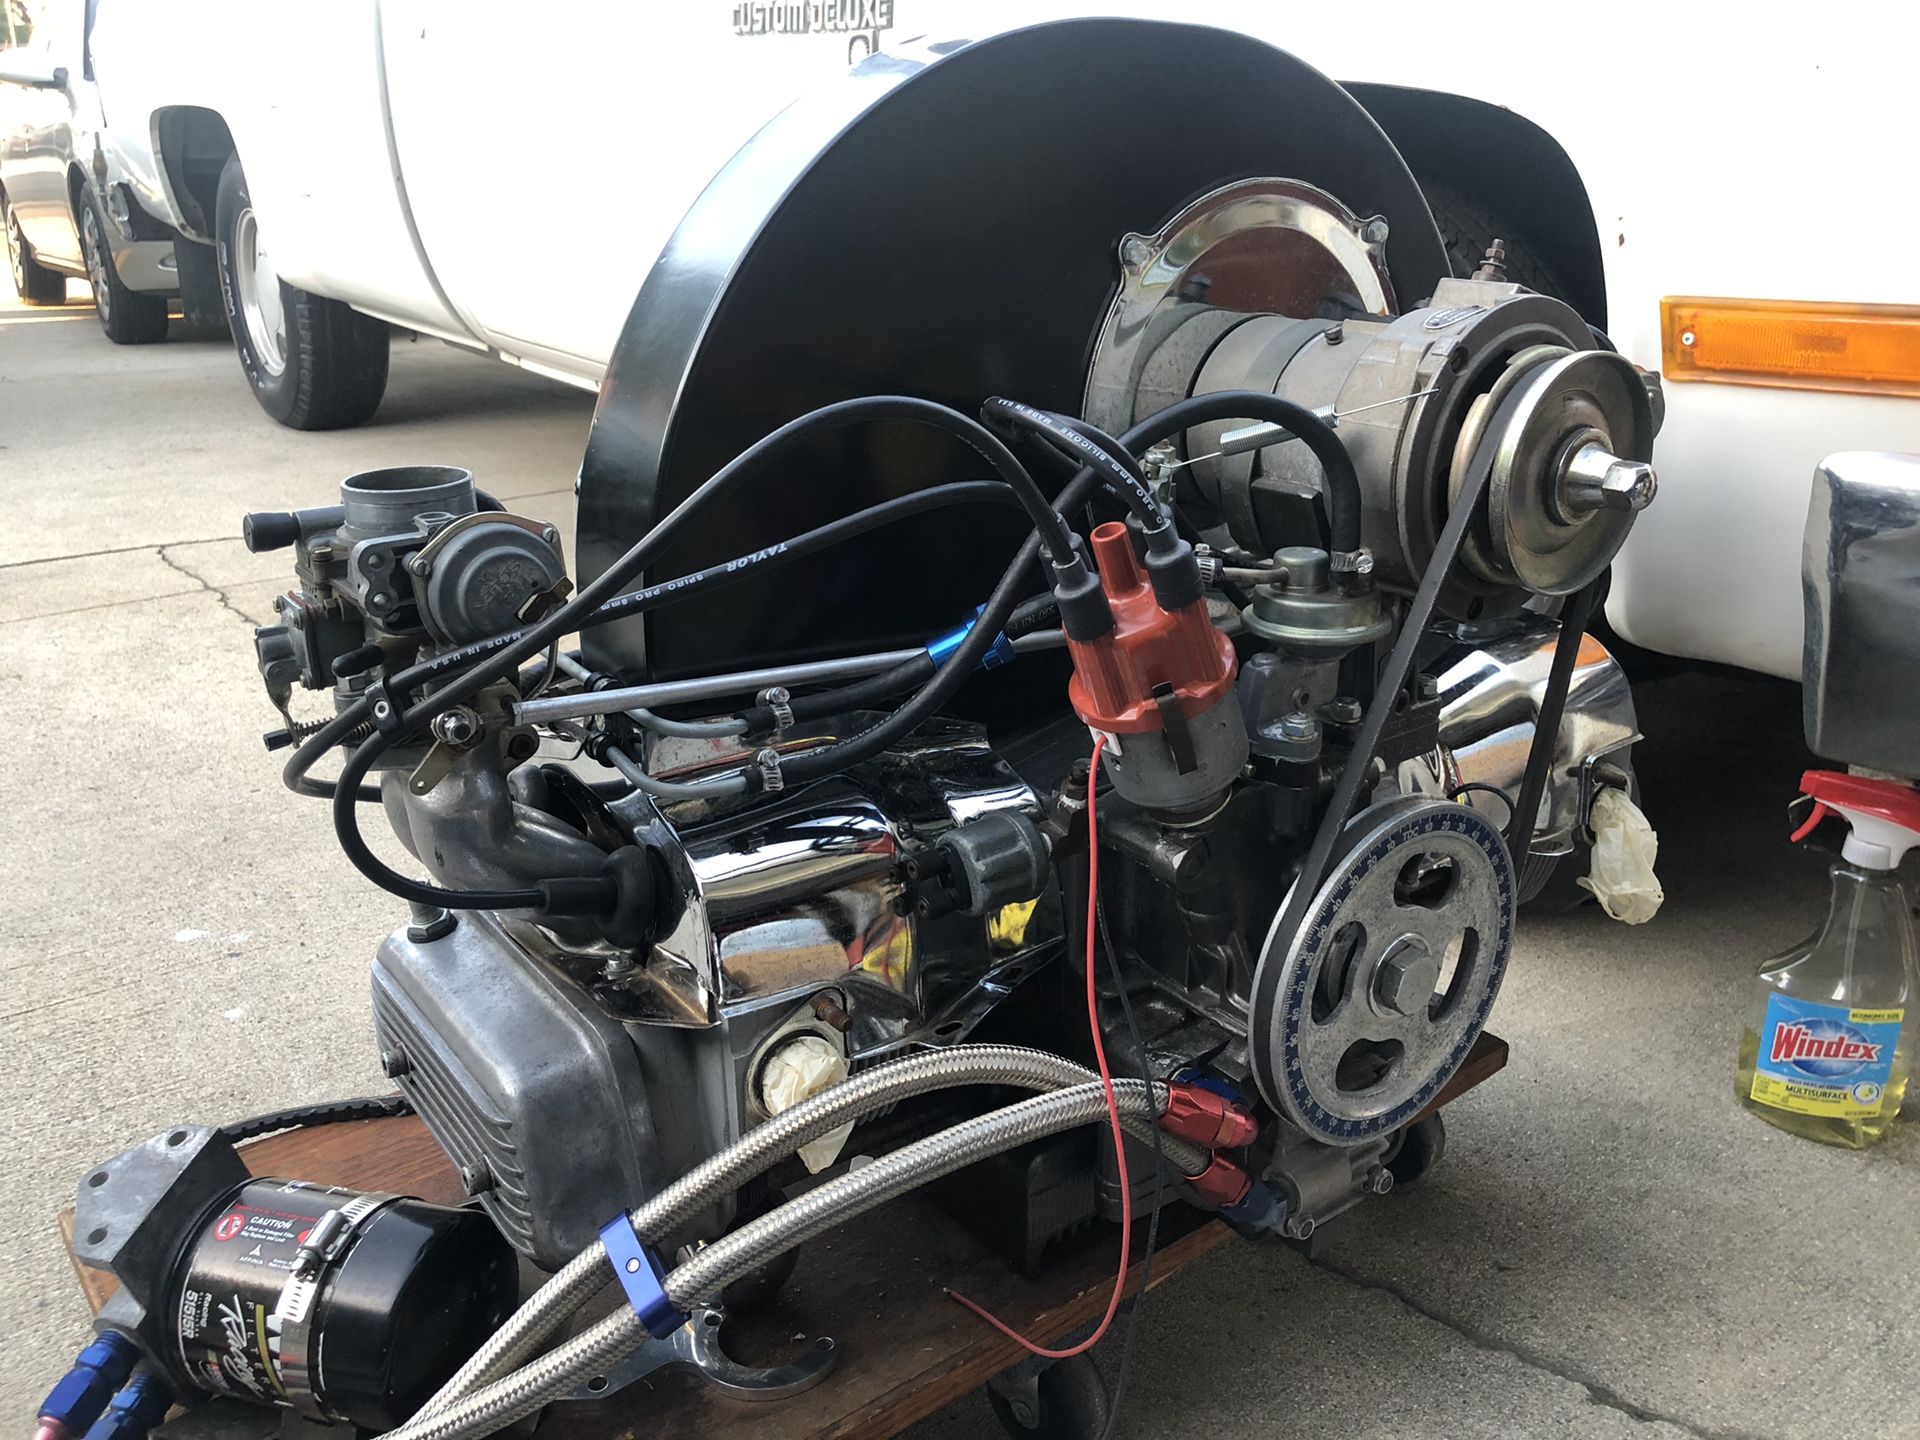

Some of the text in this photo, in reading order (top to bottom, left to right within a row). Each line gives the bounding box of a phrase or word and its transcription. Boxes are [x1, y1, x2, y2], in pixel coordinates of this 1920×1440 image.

[1060, 426, 1107, 462] SILICONE
[1110, 463, 1134, 486] 8mm
[1136, 488, 1155, 512] PRO
[726, 542, 788, 574] TAYLOR
[666, 573, 705, 593] SPIRO
[634, 586, 662, 602] PRO
[487, 631, 522, 650] MADE
[466, 644, 482, 657] IN
[1441, 820, 1451, 831] 20
[1457, 822, 1466, 833] 30
[1402, 827, 1419, 841] TDC
[1386, 839, 1397, 851] 10
[1366, 854, 1378, 869] 20
[1332, 898, 1343, 913] 40
[1296, 980, 1306, 993] 70
[1770, 1023, 1881, 1062] Windex
[1785, 1084, 1849, 1101] MULTISURFACE
[249, 1215, 293, 1230] CAUTION
[182, 1289, 198, 1340] 51515R
[201, 1292, 213, 1328] Racing
